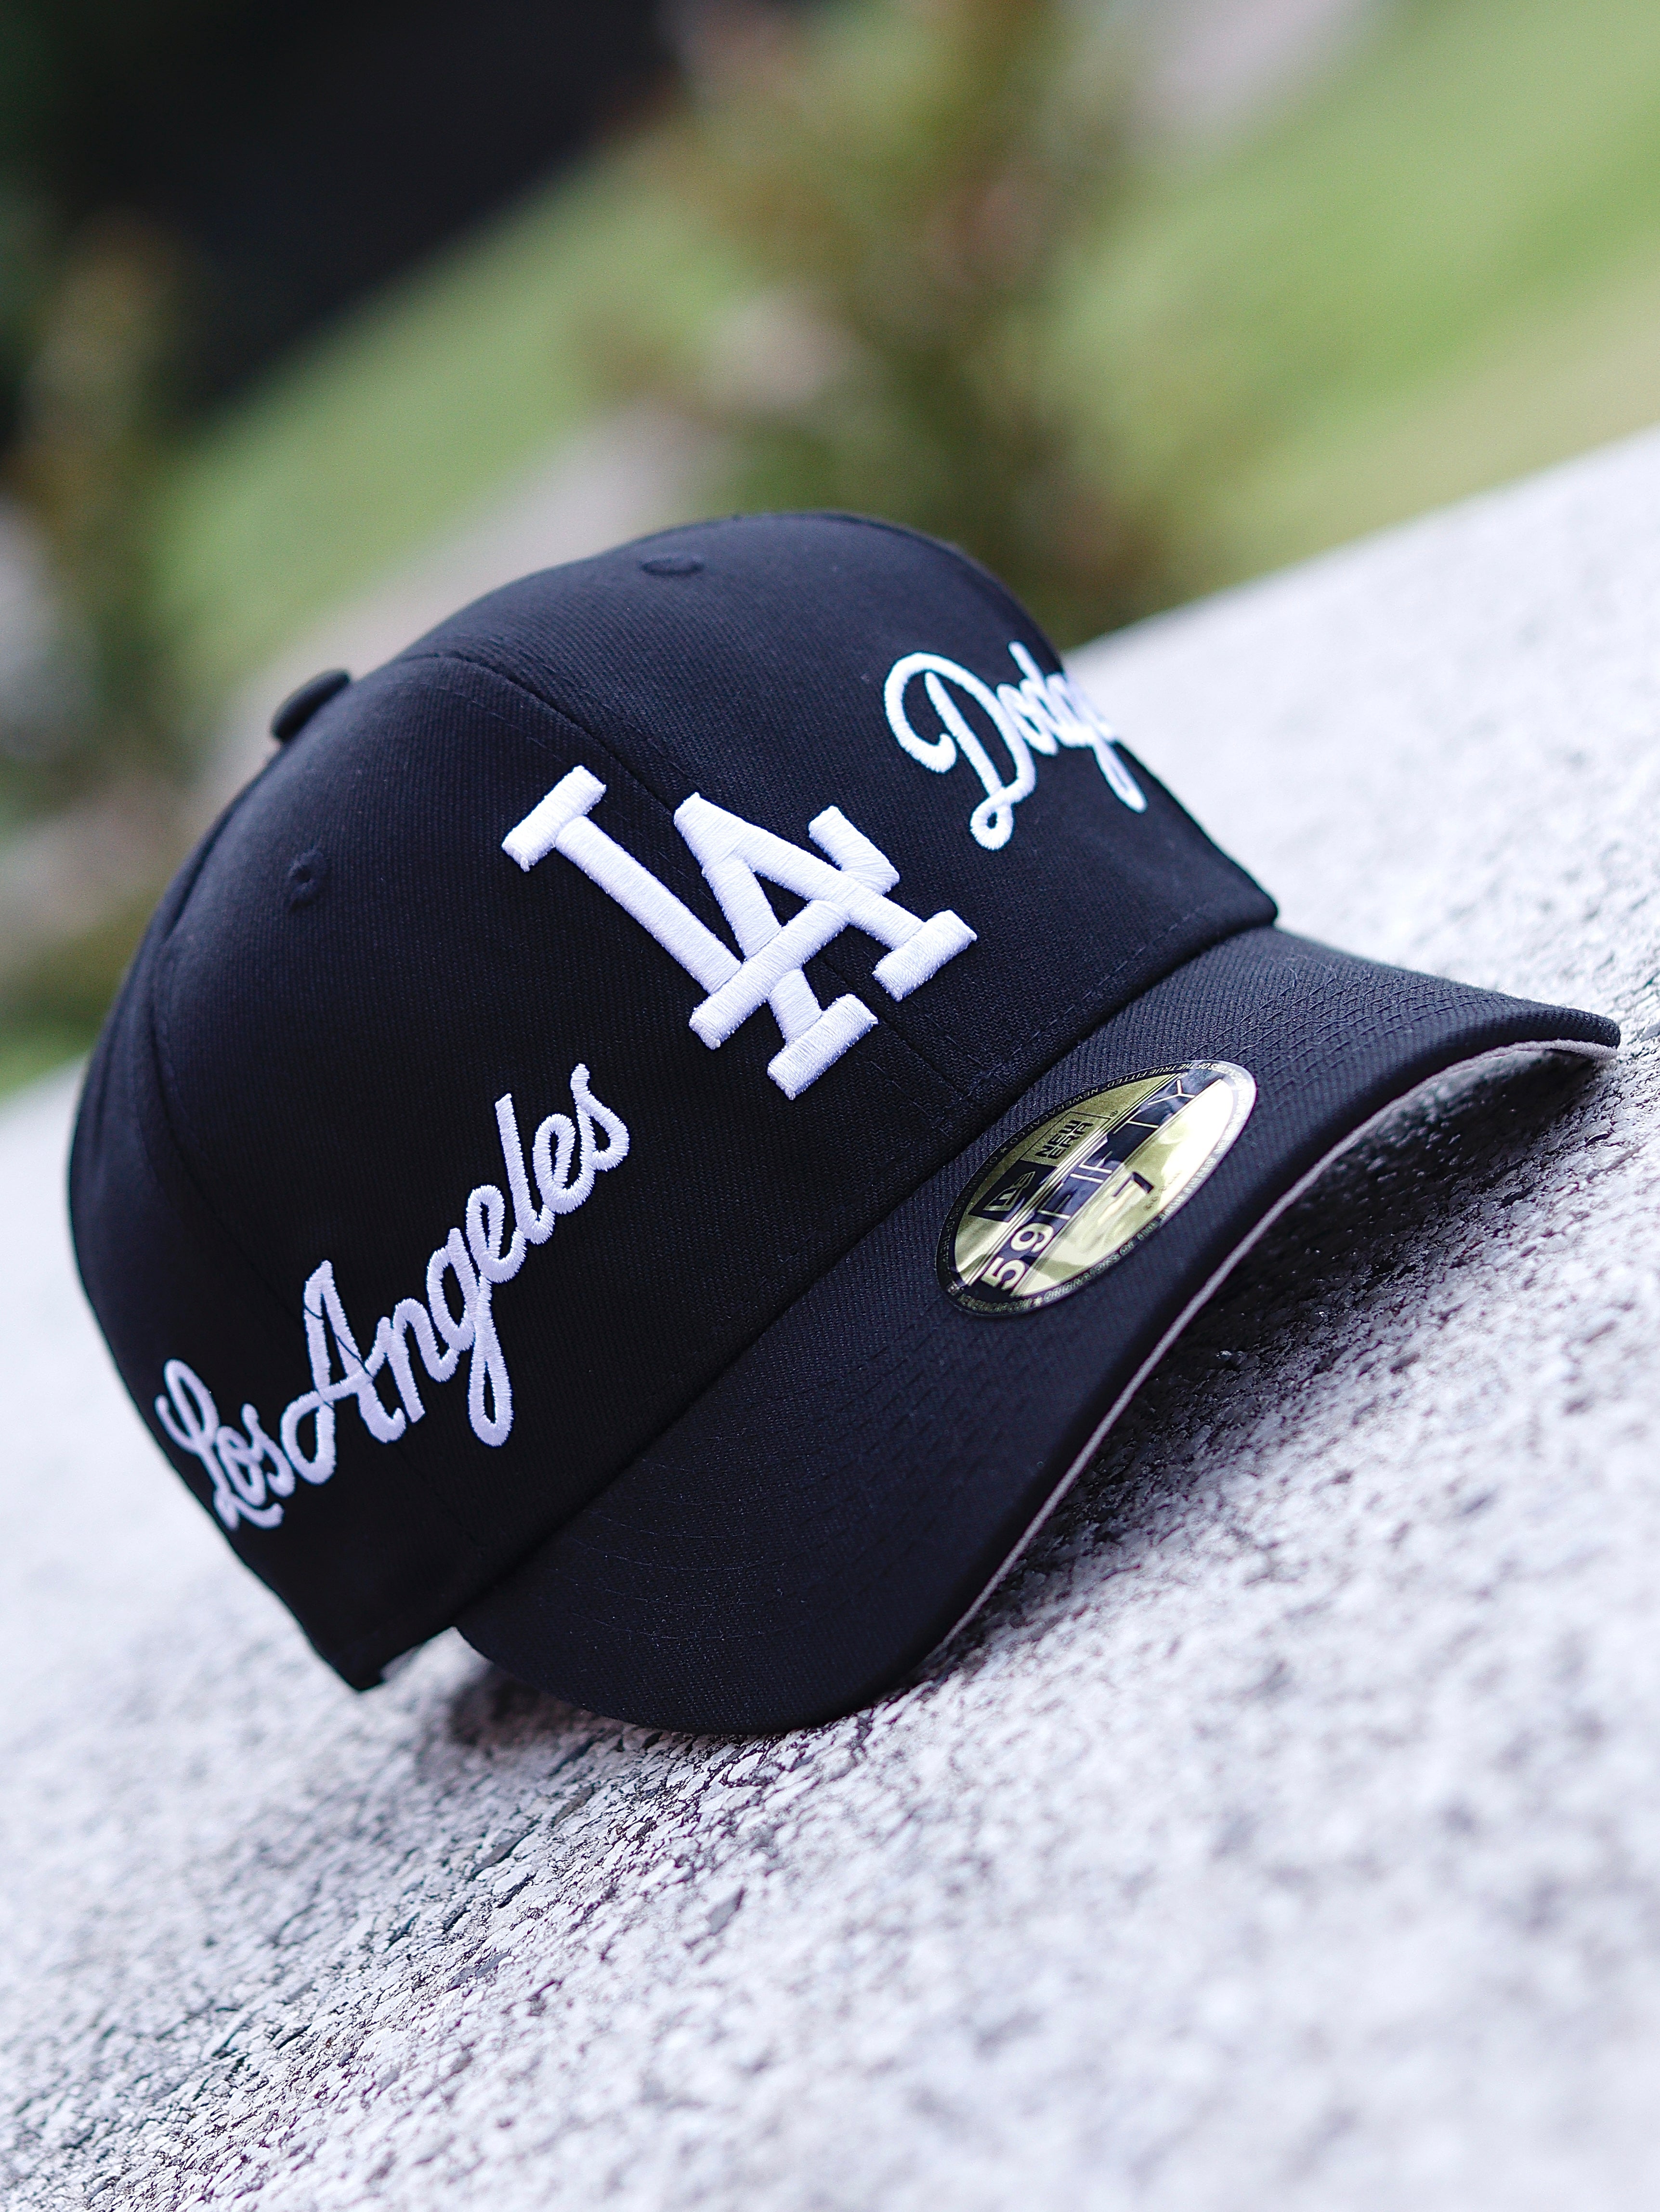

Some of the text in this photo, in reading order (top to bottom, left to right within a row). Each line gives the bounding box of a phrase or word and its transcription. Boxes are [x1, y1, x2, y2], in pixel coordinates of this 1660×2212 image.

[884, 641, 1148, 850] Dodg
[502, 765, 977, 1100] LA
[1035, 1120, 1094, 1159] NEW ERA
[1148, 1065, 1176, 1076] TRUE
[980, 1079, 1196, 1291] 59FIFTY
[1112, 1171, 1154, 1198] 7
[155, 1063, 630, 1530] Los Angeles
